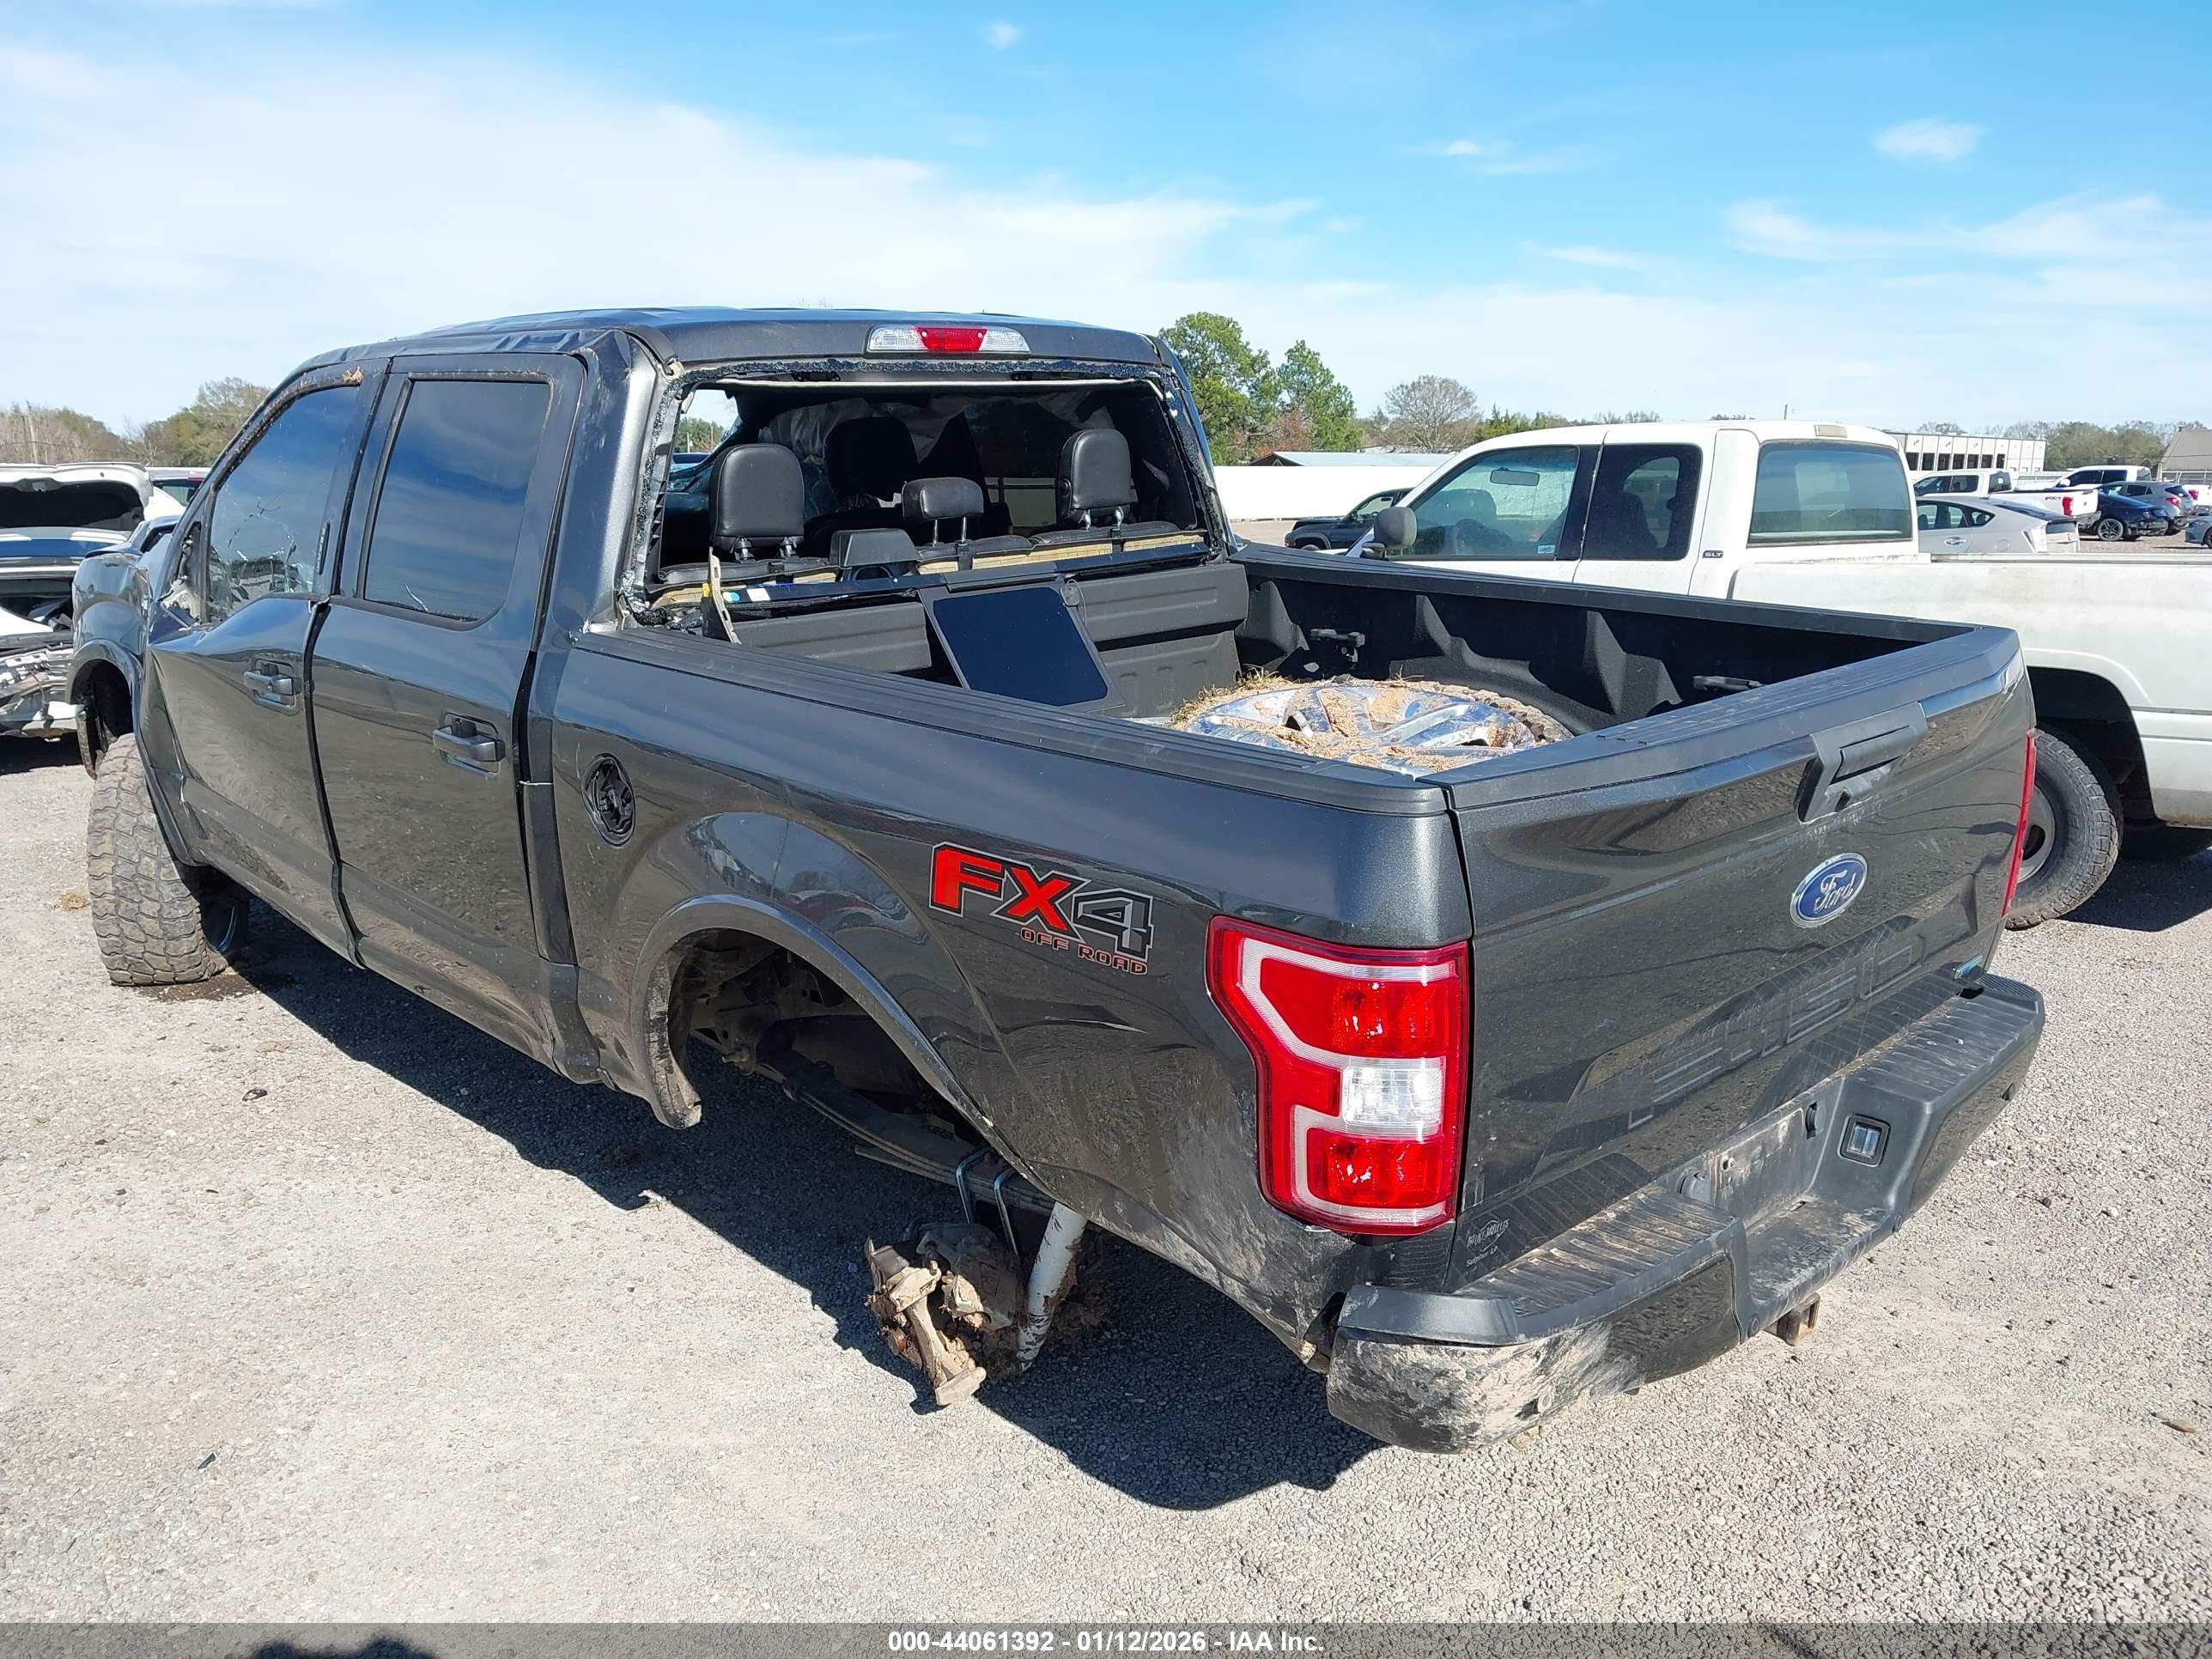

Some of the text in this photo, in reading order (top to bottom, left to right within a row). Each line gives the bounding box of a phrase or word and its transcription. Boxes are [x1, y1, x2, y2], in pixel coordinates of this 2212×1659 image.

[929, 841, 1154, 963] FX4
[1813, 869, 1856, 915] Ford
[1019, 927, 1148, 975] OFF ROAD
